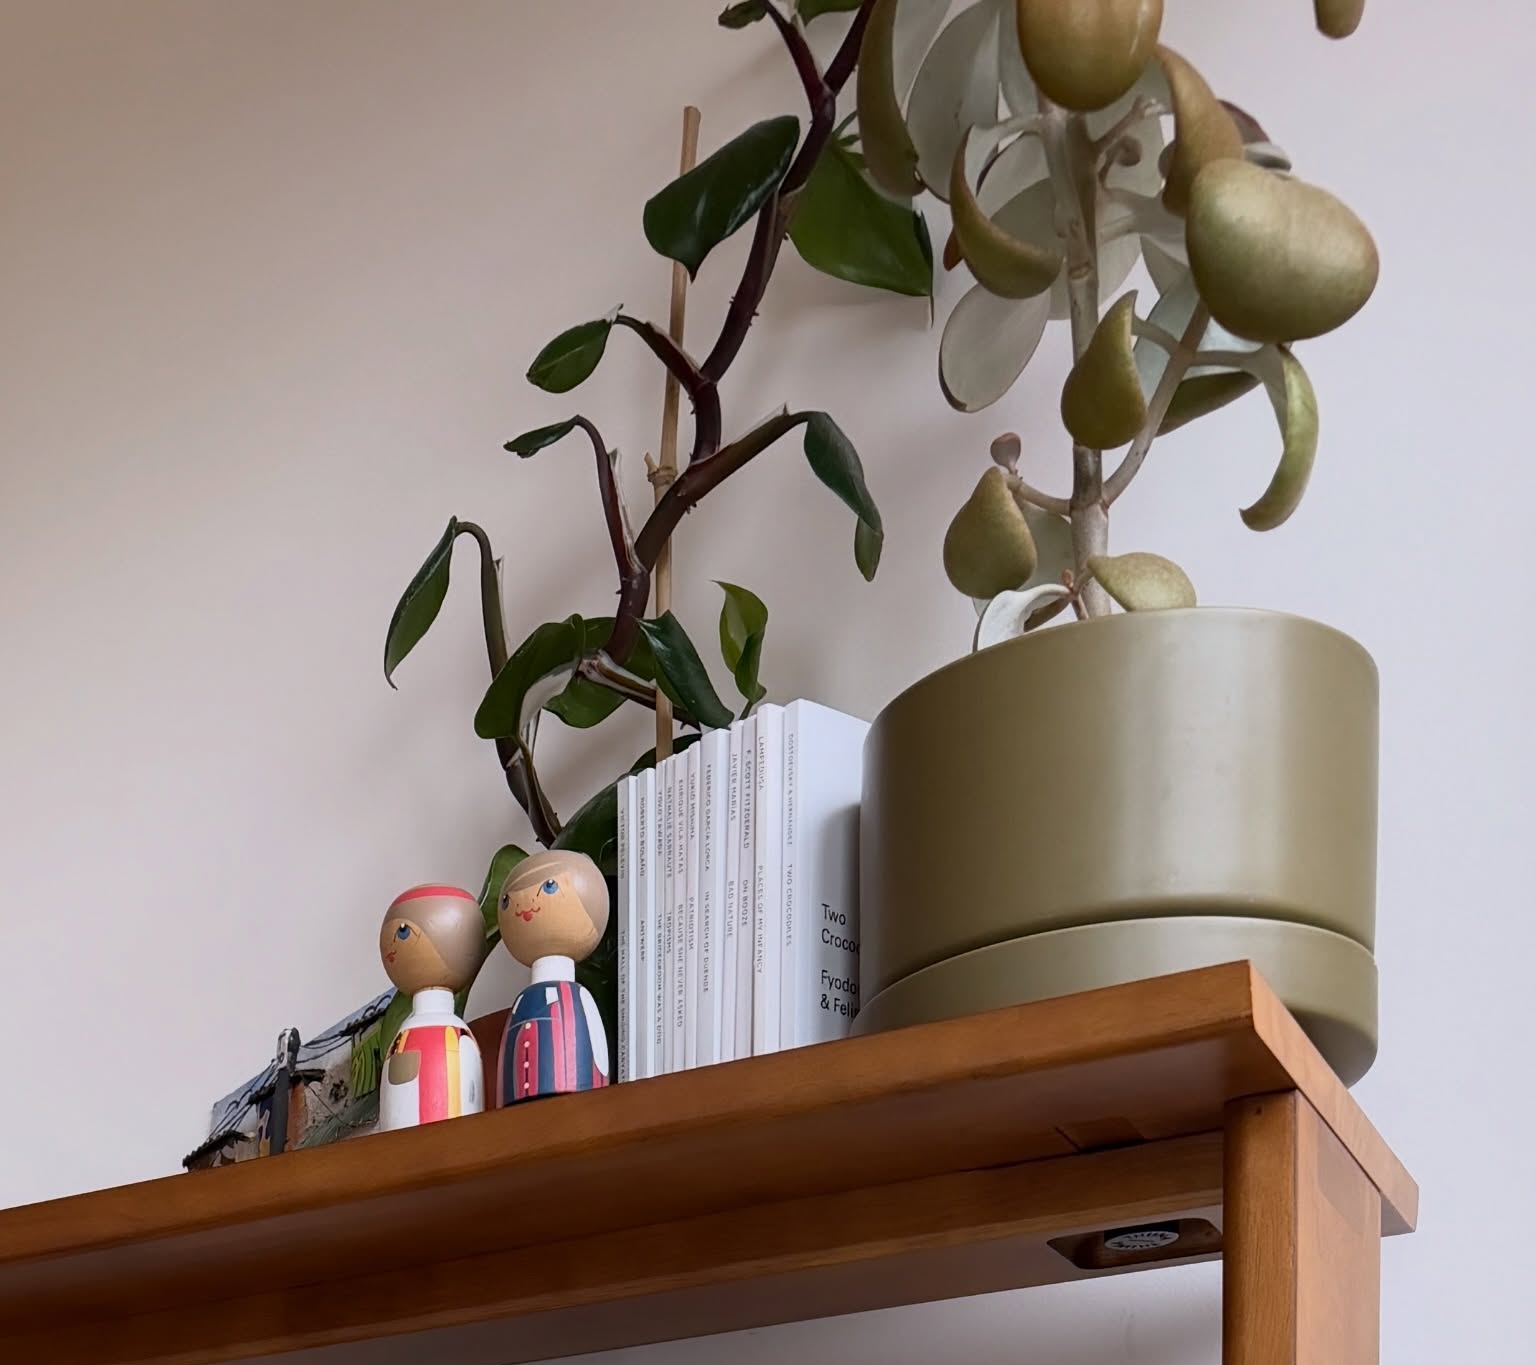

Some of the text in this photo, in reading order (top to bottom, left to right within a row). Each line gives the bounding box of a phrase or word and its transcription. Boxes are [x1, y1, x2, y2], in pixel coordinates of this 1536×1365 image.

[822, 904, 846, 926] Two
[821, 969, 860, 995] Fyodo
[821, 994, 829, 1010] &
